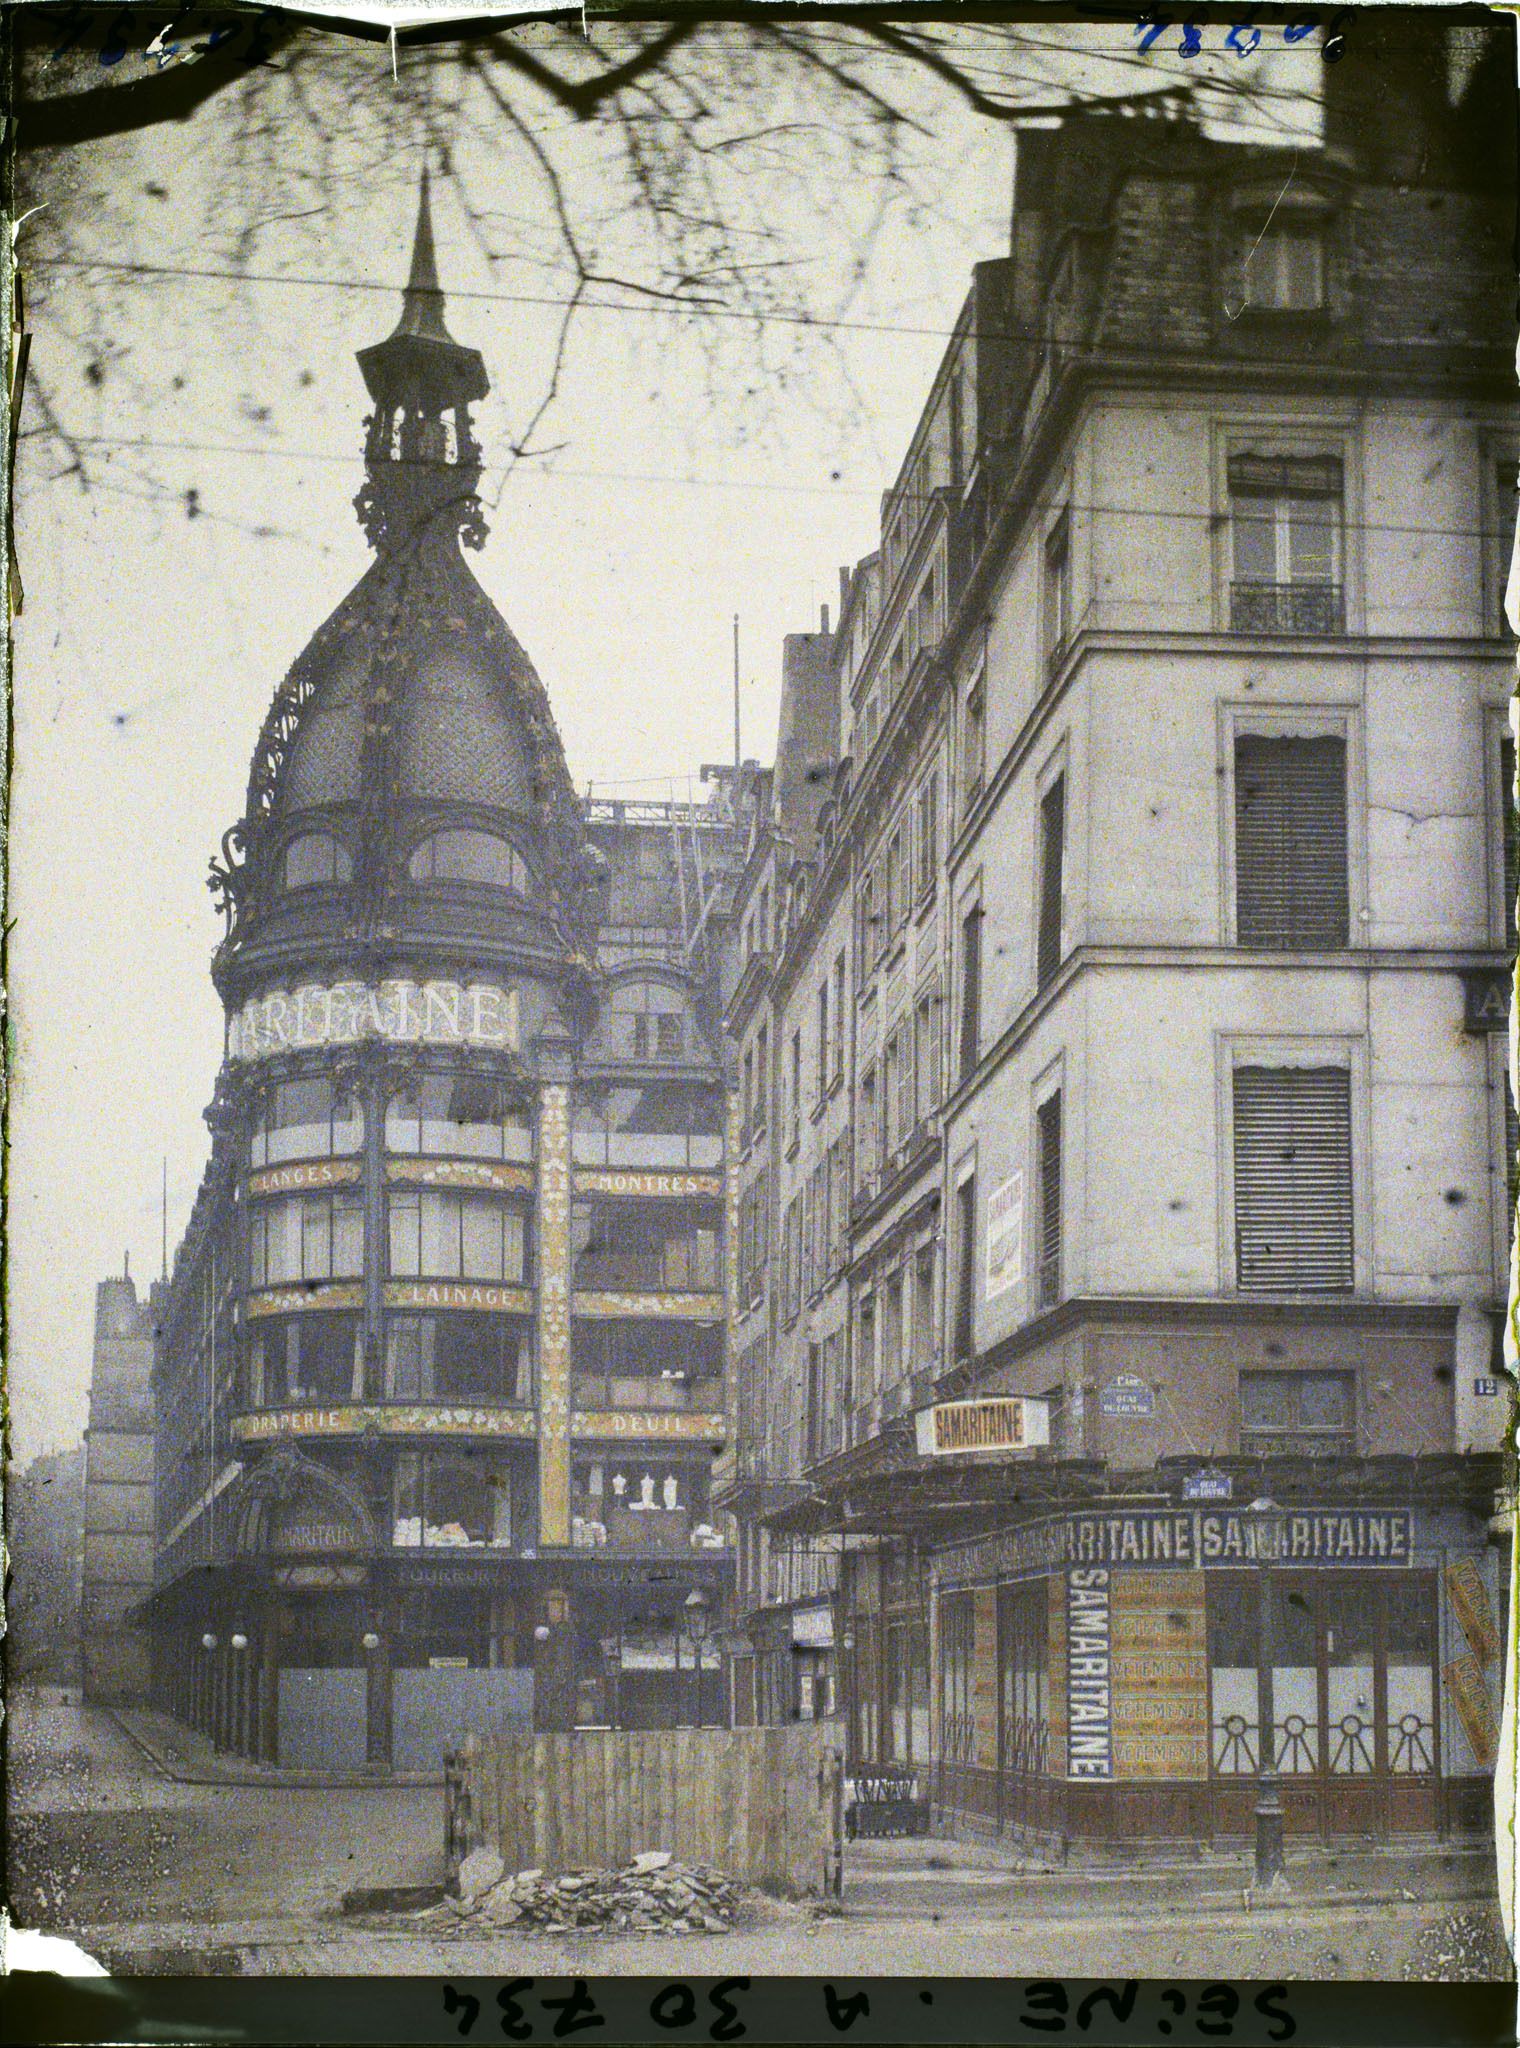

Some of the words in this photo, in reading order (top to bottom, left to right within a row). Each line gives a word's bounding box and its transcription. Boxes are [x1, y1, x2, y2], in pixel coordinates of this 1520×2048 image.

[598, 1174, 698, 1193] MONTRES
[411, 1284, 513, 1307] LAINAGE
[251, 1410, 341, 1433] DRAPERIE
[612, 1413, 685, 1434] DEUIL
[936, 1403, 1021, 1449] SAMARITAINE
[1069, 1569, 1109, 1776] SAMARITAINE
[823, 1983, 871, 2031] A
